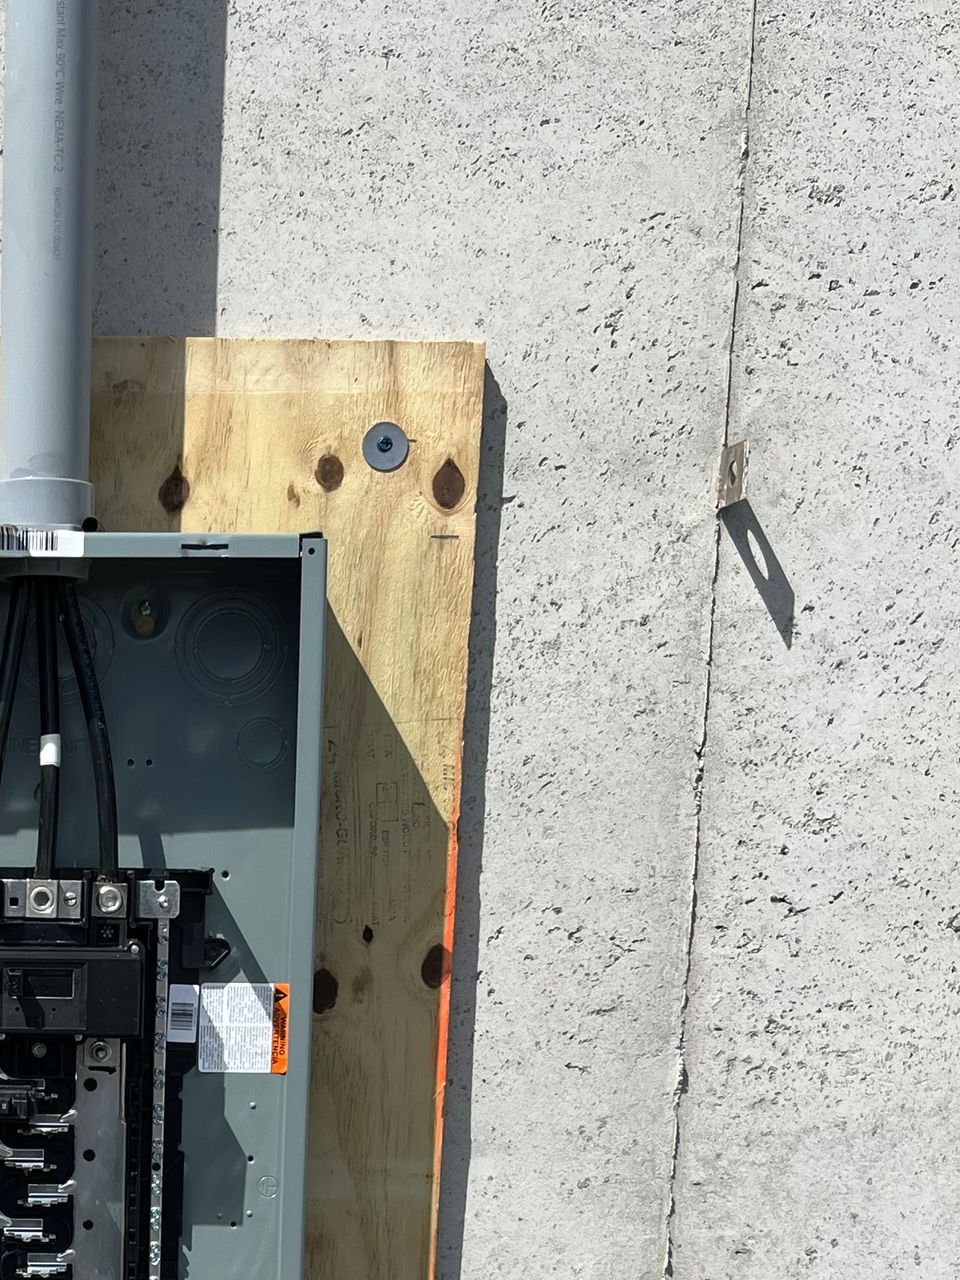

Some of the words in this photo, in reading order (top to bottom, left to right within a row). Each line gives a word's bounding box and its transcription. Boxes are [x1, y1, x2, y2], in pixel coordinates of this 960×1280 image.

[56, 28, 67, 49] Max
[54, 81, 65, 105] Wire
[53, 110, 65, 173] NEMA-TC-2
[272, 1007, 280, 1065] ADVERTENCIA
[279, 1016, 287, 1056] WARNING
